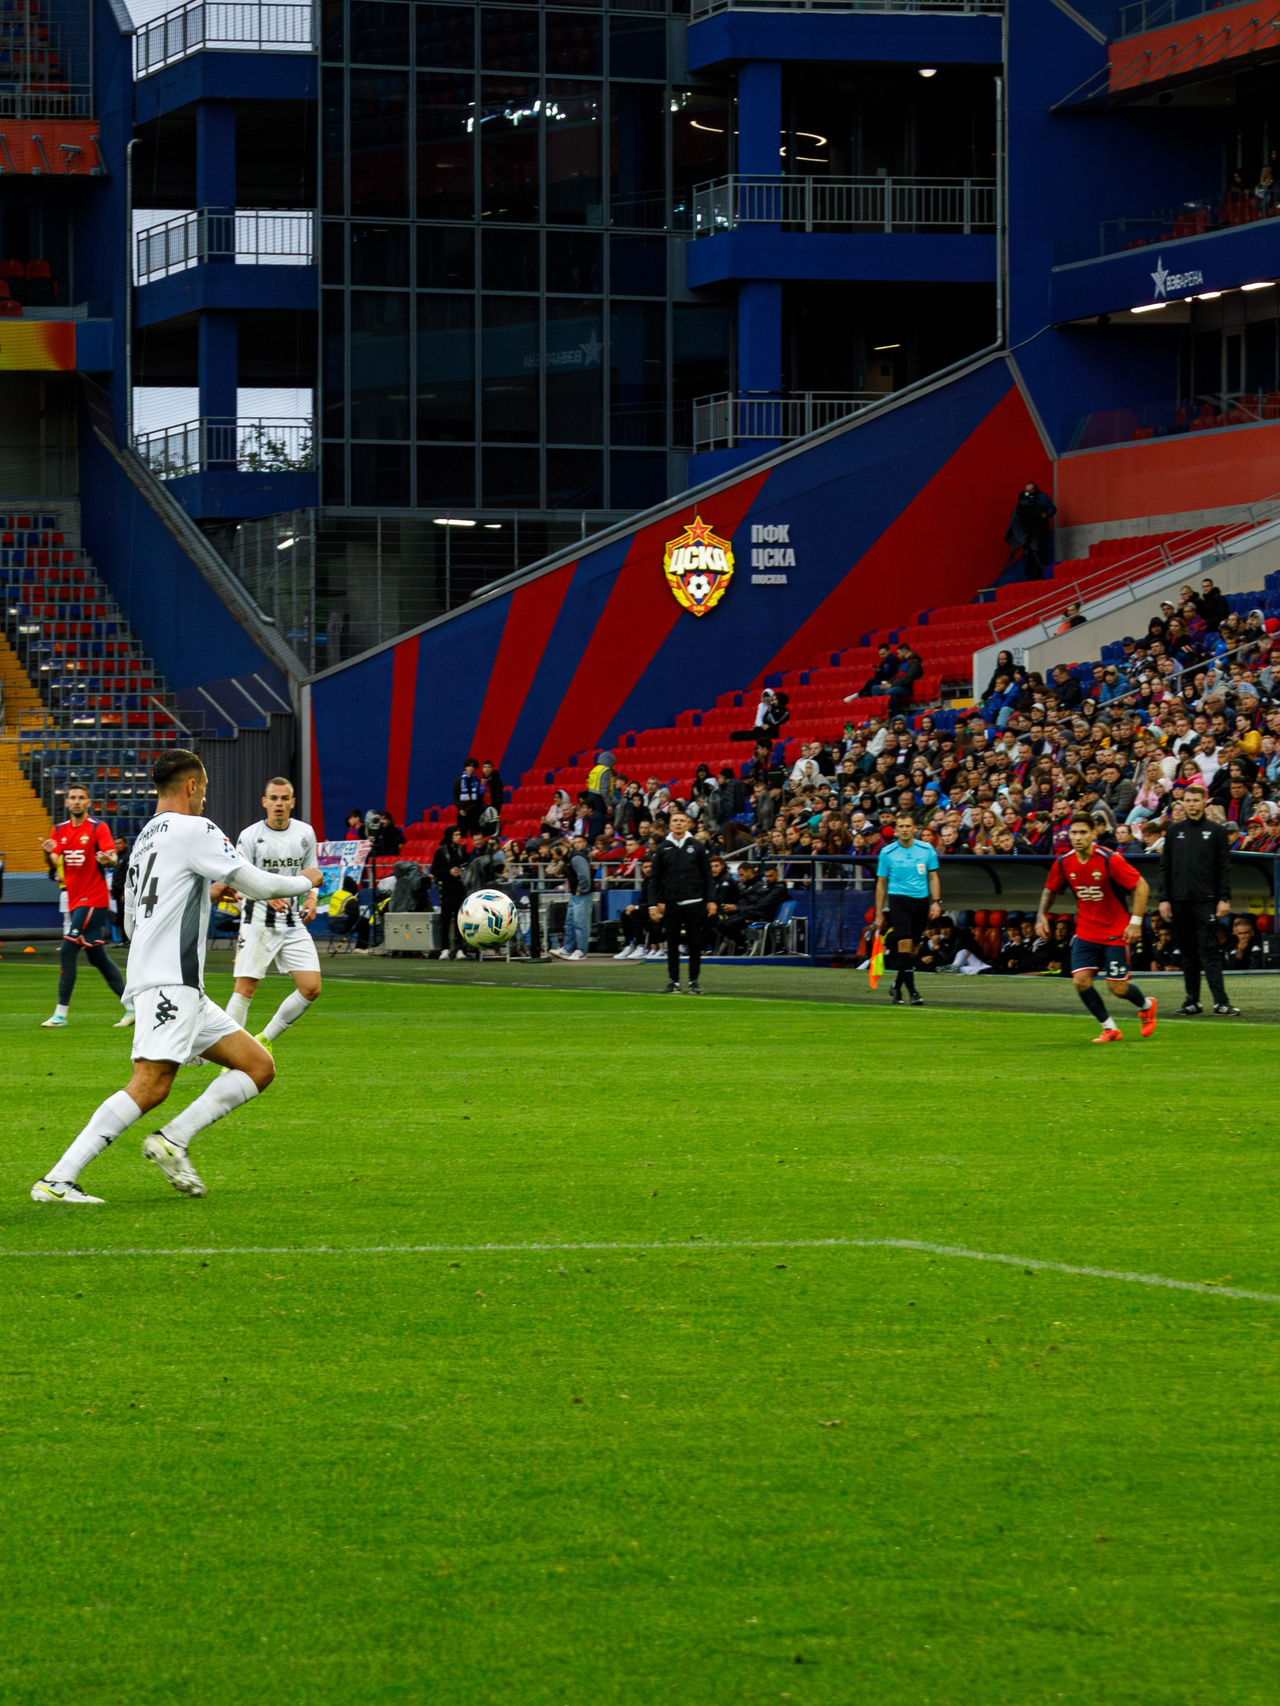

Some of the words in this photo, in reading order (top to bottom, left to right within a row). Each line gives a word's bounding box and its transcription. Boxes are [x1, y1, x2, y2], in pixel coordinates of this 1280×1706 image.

[751, 524, 790, 543] ПФК
[668, 545, 730, 575] ЦСКА
[751, 548, 796, 570] ЦСКА
[1109, 960, 1119, 976] 5
